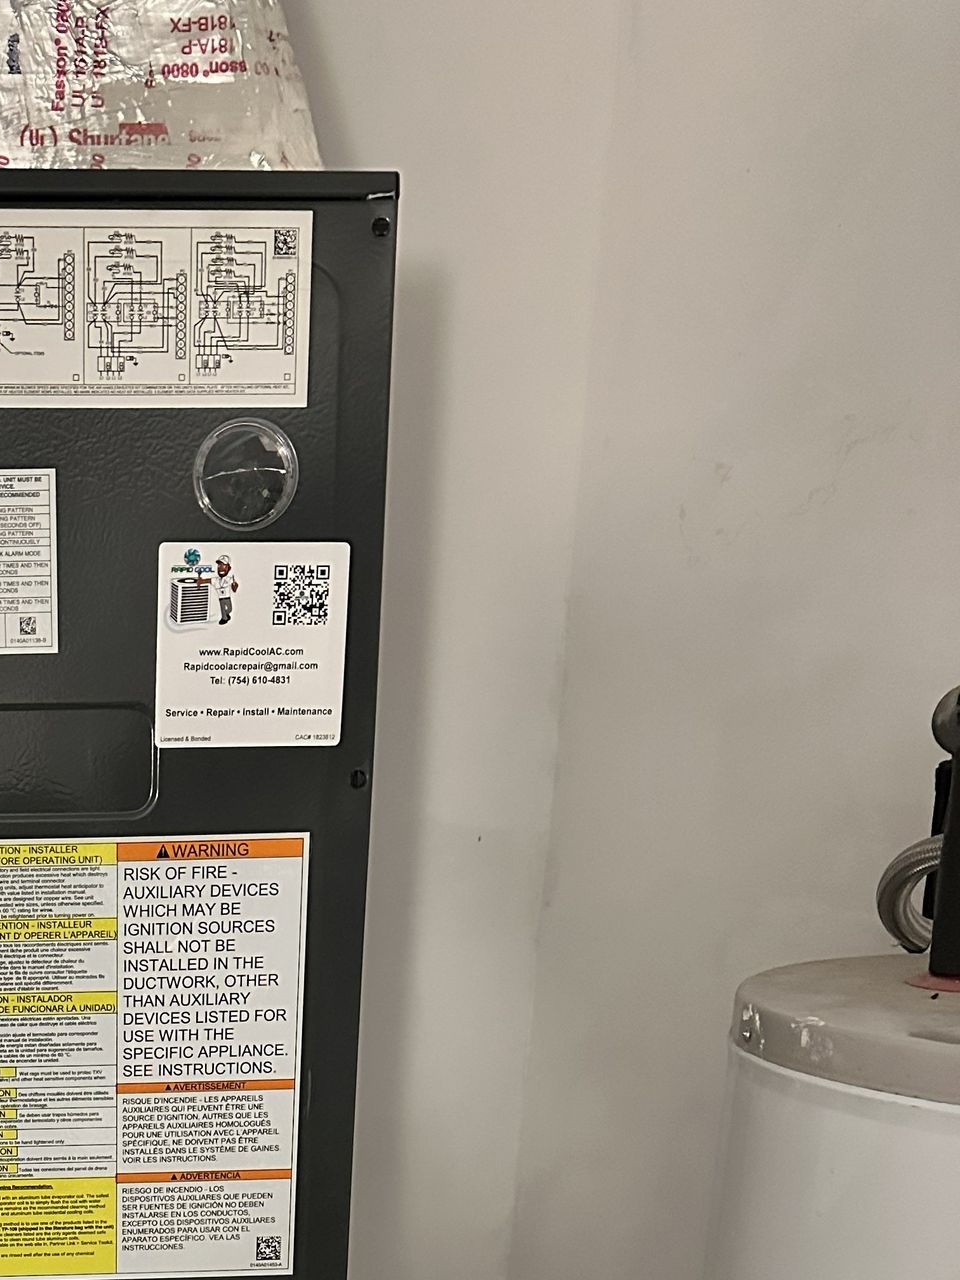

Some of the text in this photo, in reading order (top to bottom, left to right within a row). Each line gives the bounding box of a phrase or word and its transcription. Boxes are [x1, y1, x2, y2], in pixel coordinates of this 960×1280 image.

[199, 648, 304, 657] www.RapidCoolAC.com
[184, 662, 318, 672] Rapidcoolacrepair@gmail.com
[210, 676, 290, 686] Tel: (754) 610-4831
[166, 707, 332, 718] Service Repair Install Maintenance
[28, 845, 77, 854] INSTALLER
[172, 843, 249, 858] WARNING
[23, 856, 76, 866] OPERATING
[78, 856, 102, 865] UNIT)
[124, 866, 227, 881] RISK OF FIRE
[123, 883, 279, 900] AUXILIARY DEVICES
[124, 902, 241, 918] WHICH MAY BE
[37, 921, 92, 929] INSTALLEUR
[124, 920, 275, 936] IGNITION SOURCES
[24, 931, 61, 940] OPERER
[63, 930, 117, 940] L'APPAREIL)
[124, 941, 172, 954] SHALL
[178, 940, 210, 952] NOT
[215, 939, 235, 952] BE
[124, 957, 264, 972] INSTALLED IN THE
[124, 974, 279, 990] DUCTWORK, OTHER
[124, 992, 250, 1008] THAN AUXILIARY
[124, 1009, 286, 1025] DEVICES LISTED FOR
[123, 1028, 234, 1042] USE WITH THE
[123, 1044, 288, 1060] SPECIFIC APPLIANCE.
[123, 1062, 276, 1077] SEE INSTRUCTIONS.
[173, 1082, 246, 1091] AVERTISSEMENT
[122, 1097, 152, 1105] RISQUE
[180, 1172, 240, 1180] ADVERTENCIA
